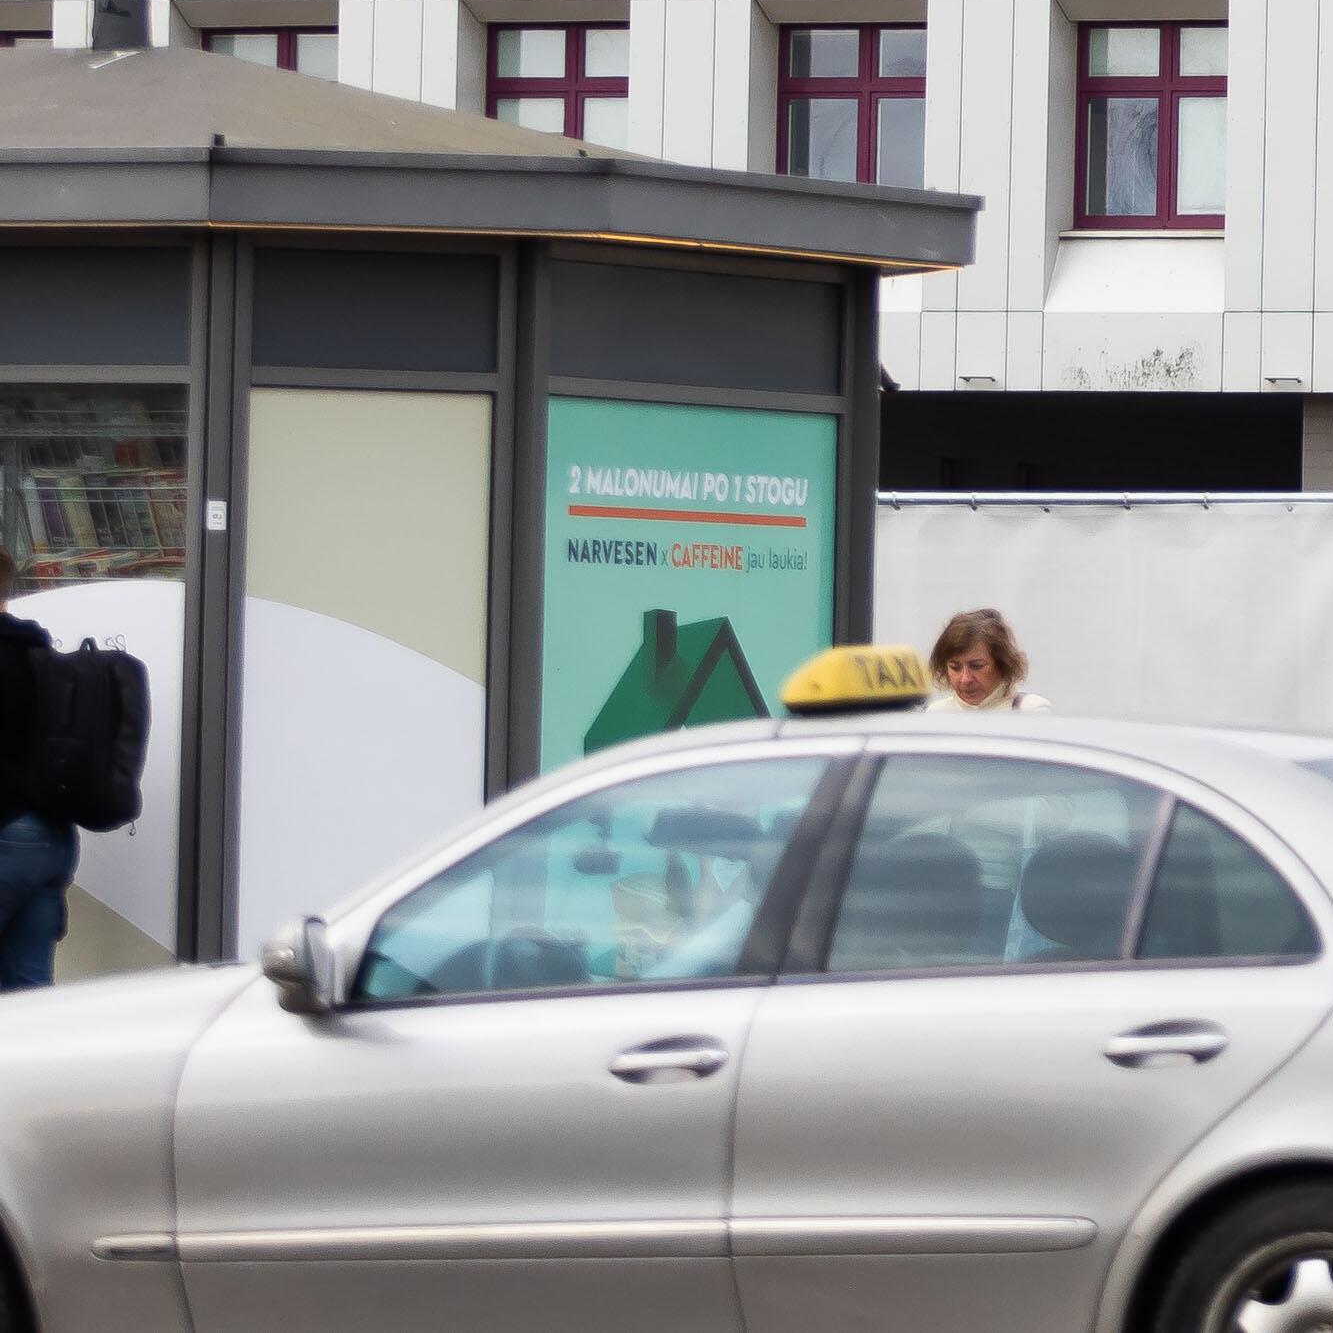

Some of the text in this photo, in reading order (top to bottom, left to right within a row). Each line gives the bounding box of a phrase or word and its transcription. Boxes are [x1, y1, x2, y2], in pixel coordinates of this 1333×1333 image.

[568, 465, 809, 507] 2 MALONUMAI PO 1 STOGU
[567, 538, 657, 566] NARVESEN
[671, 542, 743, 570] CAFFEINE
[746, 545, 765, 573] jau
[769, 546, 808, 571] laukia!
[854, 654, 926, 691] TAXI
